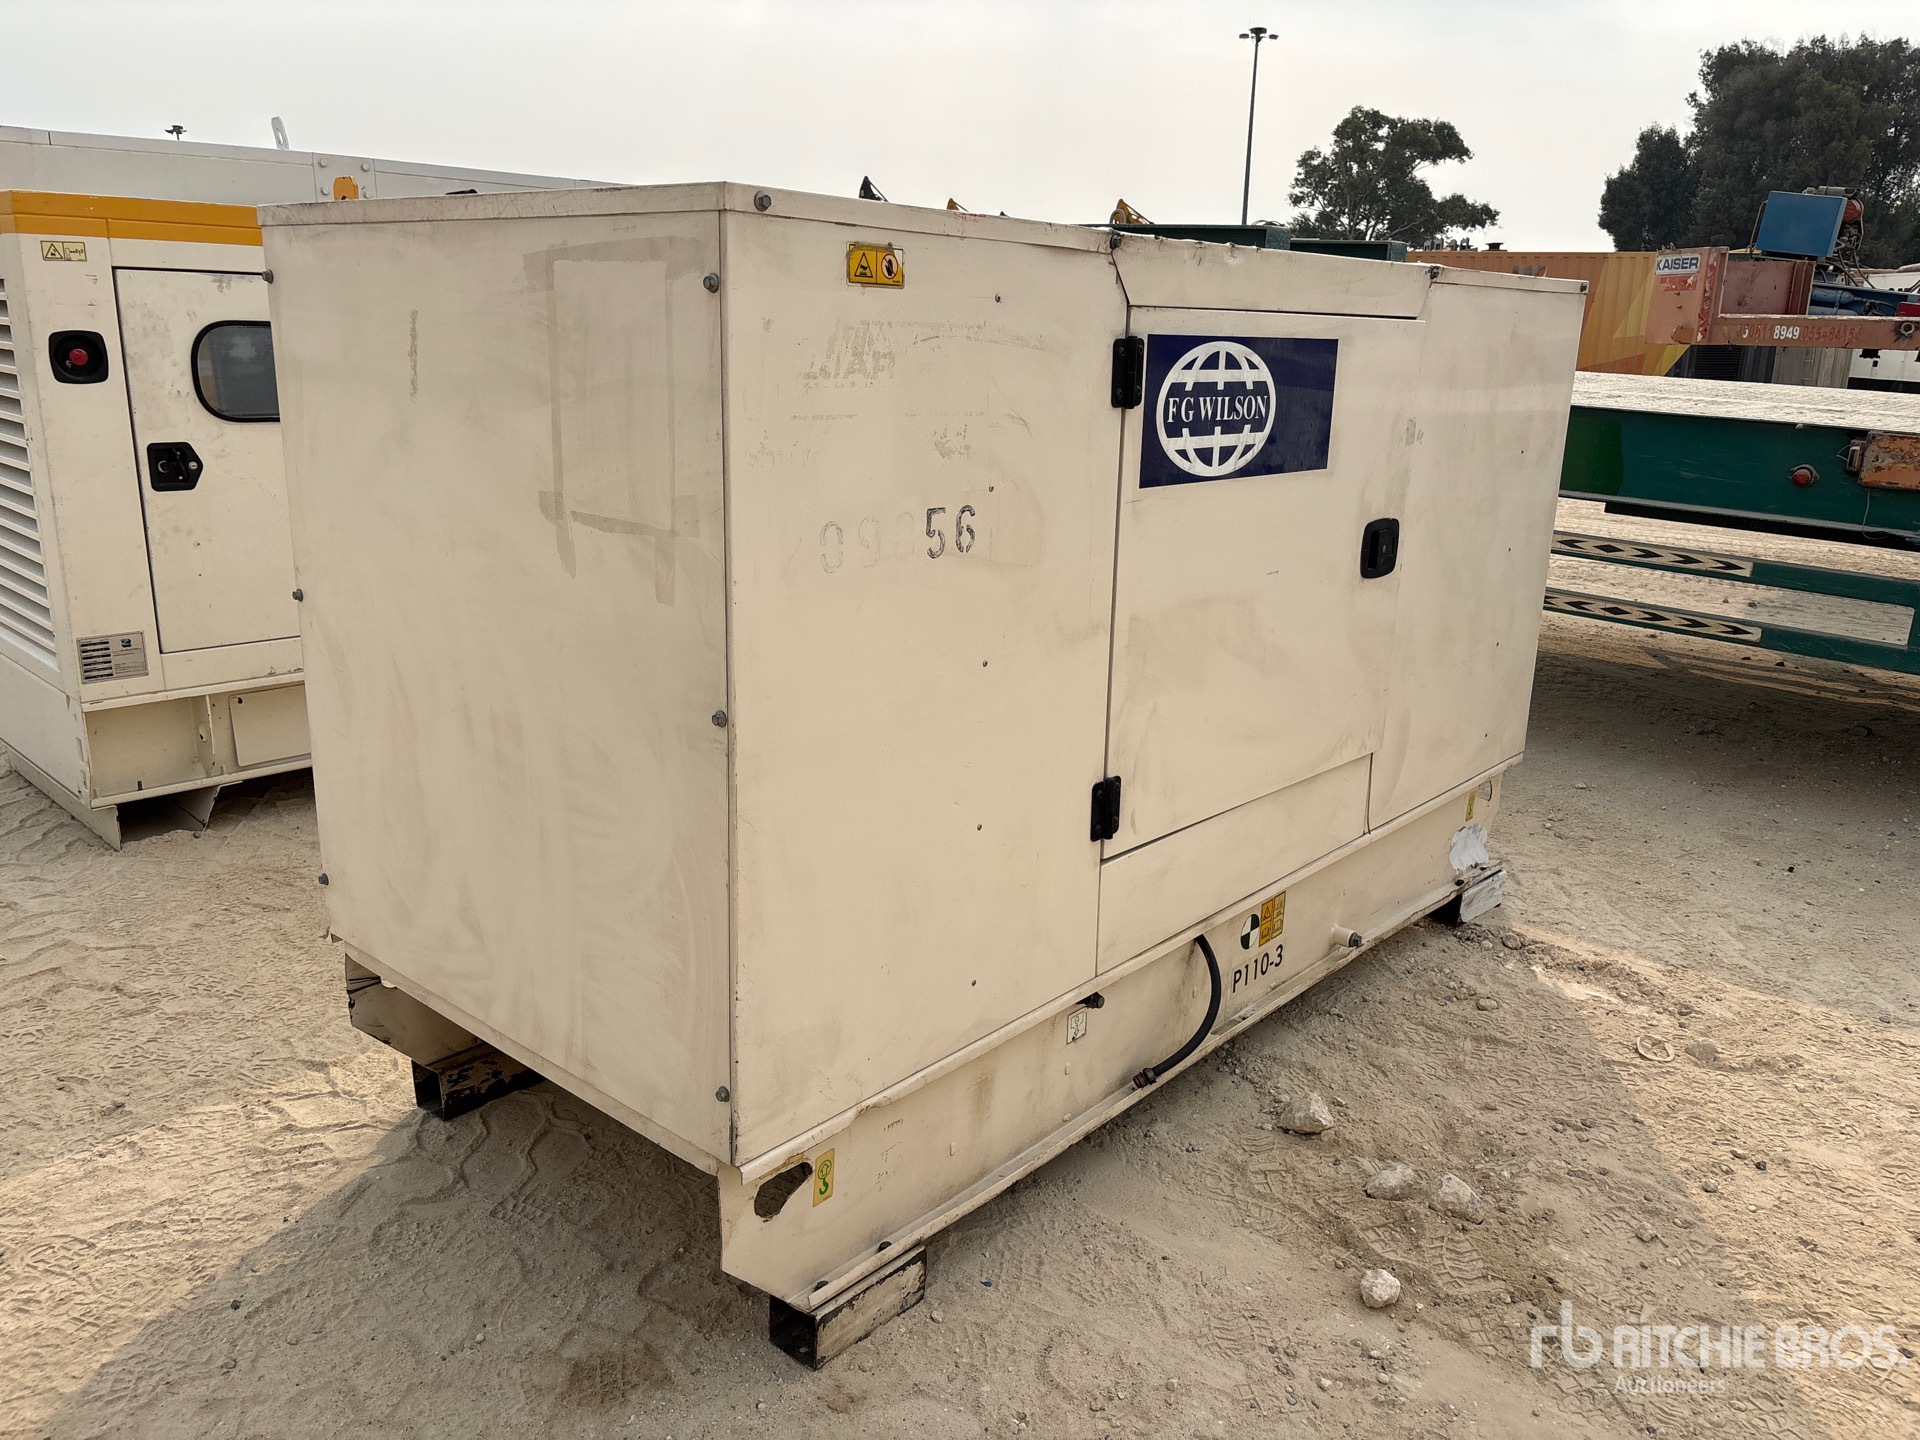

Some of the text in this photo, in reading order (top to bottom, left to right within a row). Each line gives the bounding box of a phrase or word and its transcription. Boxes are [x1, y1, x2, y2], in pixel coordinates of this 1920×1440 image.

[1656, 257, 1699, 276] KAISER
[1197, 393, 1267, 421] WILSON
[1232, 943, 1284, 994] P110-3
